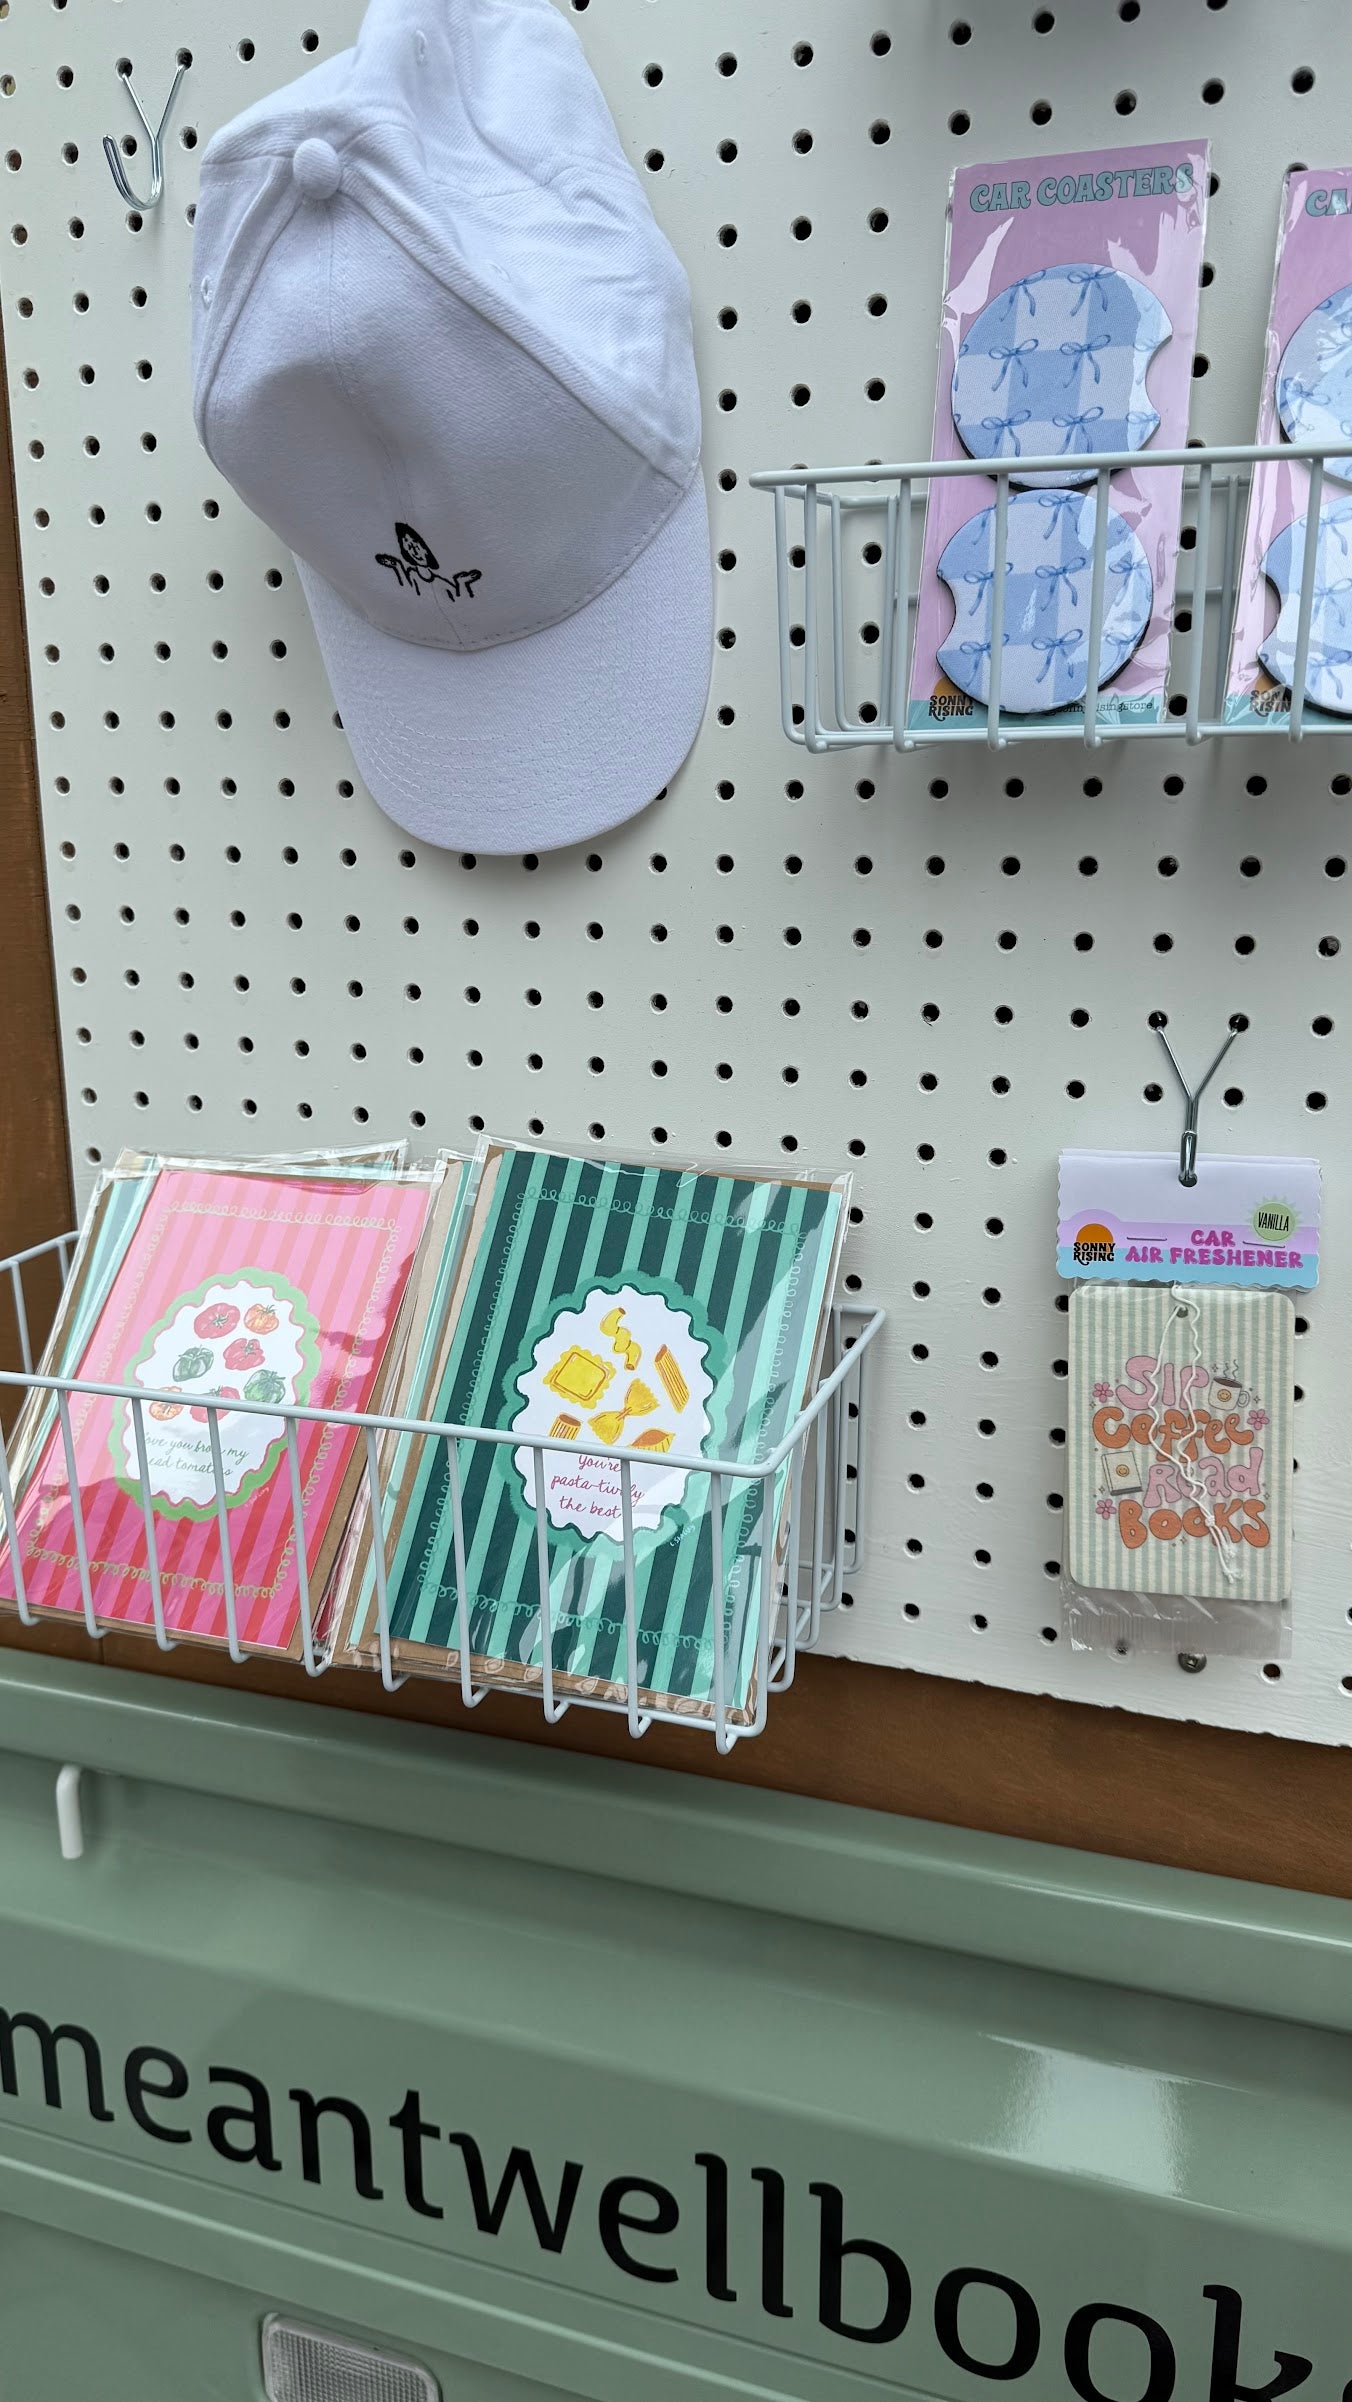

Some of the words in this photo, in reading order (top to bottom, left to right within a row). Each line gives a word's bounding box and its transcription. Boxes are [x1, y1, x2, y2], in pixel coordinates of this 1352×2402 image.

[970, 180, 1031, 213] CAR
[1036, 163, 1194, 207] COASTERS
[1305, 188, 1352, 217] CA
[928, 705, 974, 722] RISING
[1248, 701, 1291, 718] RISIN
[1257, 1211, 1290, 1232] VANILLA
[1073, 1241, 1116, 1252] SONNY
[1190, 1229, 1236, 1248] CAR
[1073, 1251, 1115, 1266] RISING
[1125, 1246, 1164, 1264] AIR
[1169, 1247, 1304, 1269] FRESHENER
[1092, 1406, 1255, 1464] Coffee
[145, 1432, 168, 1447] ove
[168, 1439, 193, 1456] you
[227, 1447, 250, 1466] my
[148, 1455, 175, 1469] ead
[175, 1459, 234, 1476] tomats
[1143, 1446, 1264, 1509] Read
[550, 1475, 645, 1508] pasta-tivly
[560, 1495, 588, 1512] the
[589, 1501, 622, 1519] best
[0, 2006, 1352, 2402] meantwellbook
